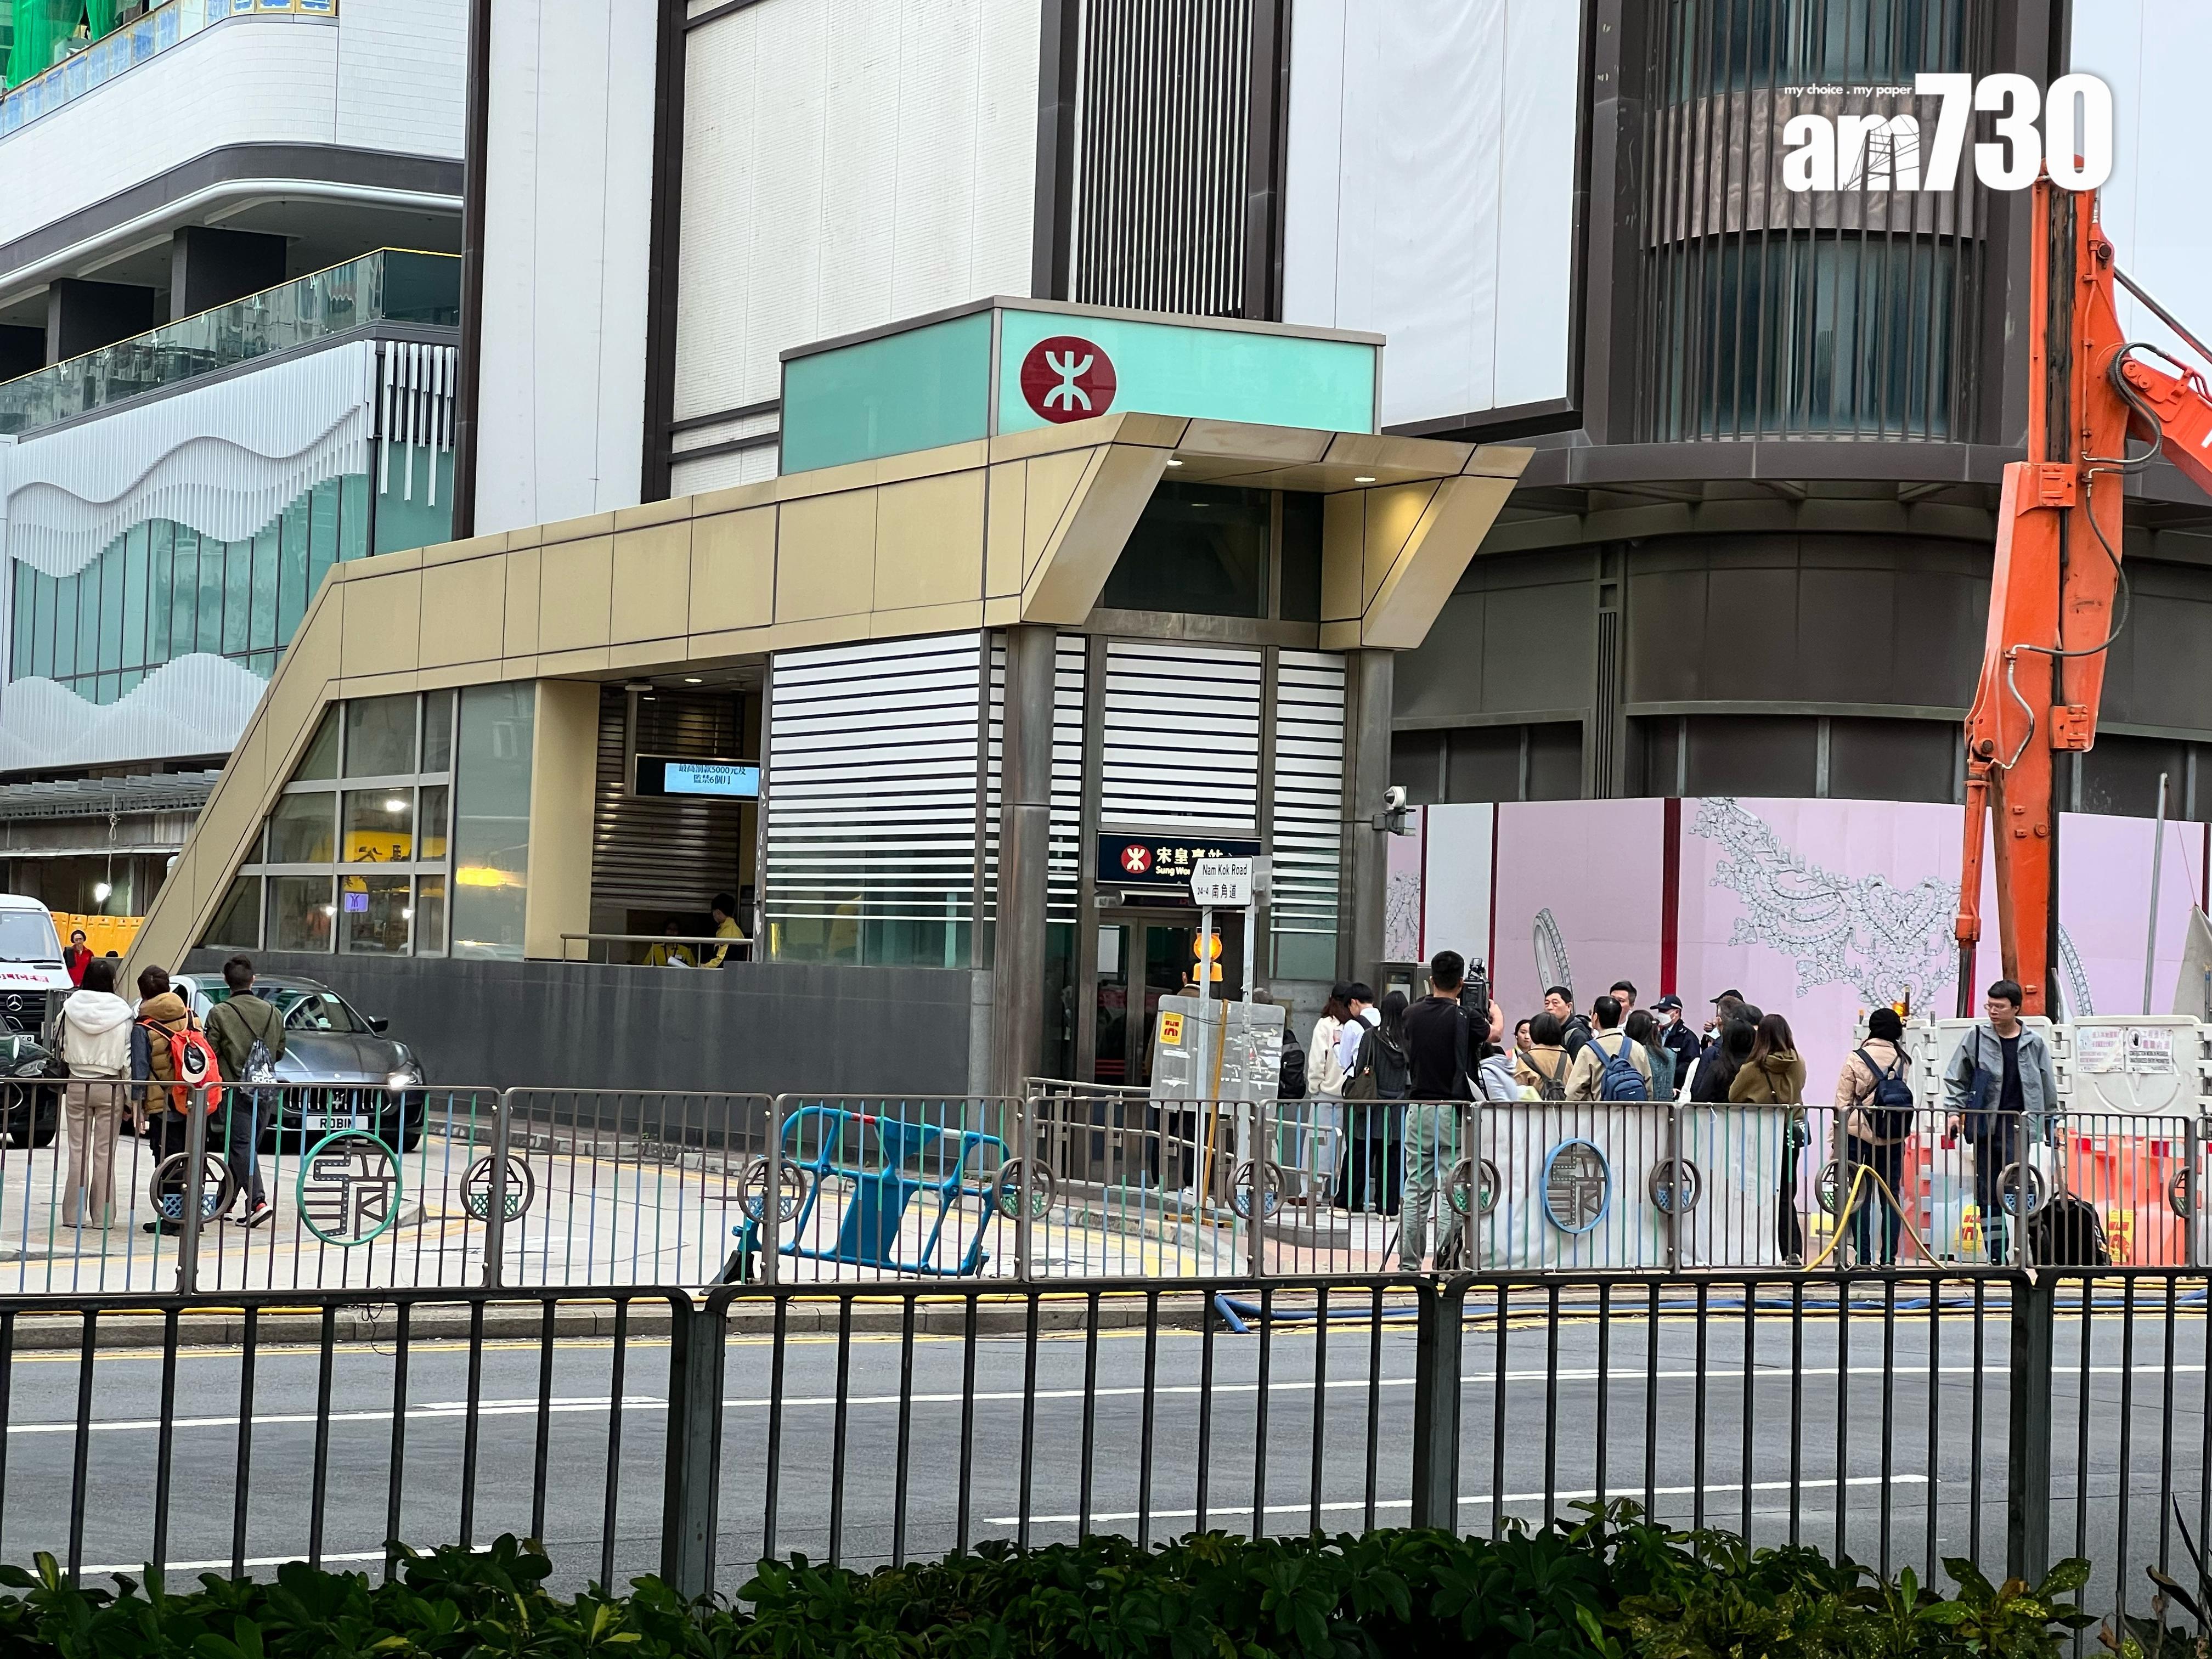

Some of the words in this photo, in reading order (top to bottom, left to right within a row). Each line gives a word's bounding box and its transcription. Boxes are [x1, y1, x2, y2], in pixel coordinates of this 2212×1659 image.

[1155, 866, 1175, 876] Sung
[1203, 864, 1217, 876] Nam
[1217, 864, 1230, 876] Kok
[1231, 864, 1247, 876] Road
[1211, 883, 1237, 899] 南角道
[320, 1118, 352, 1129] ROBIN
